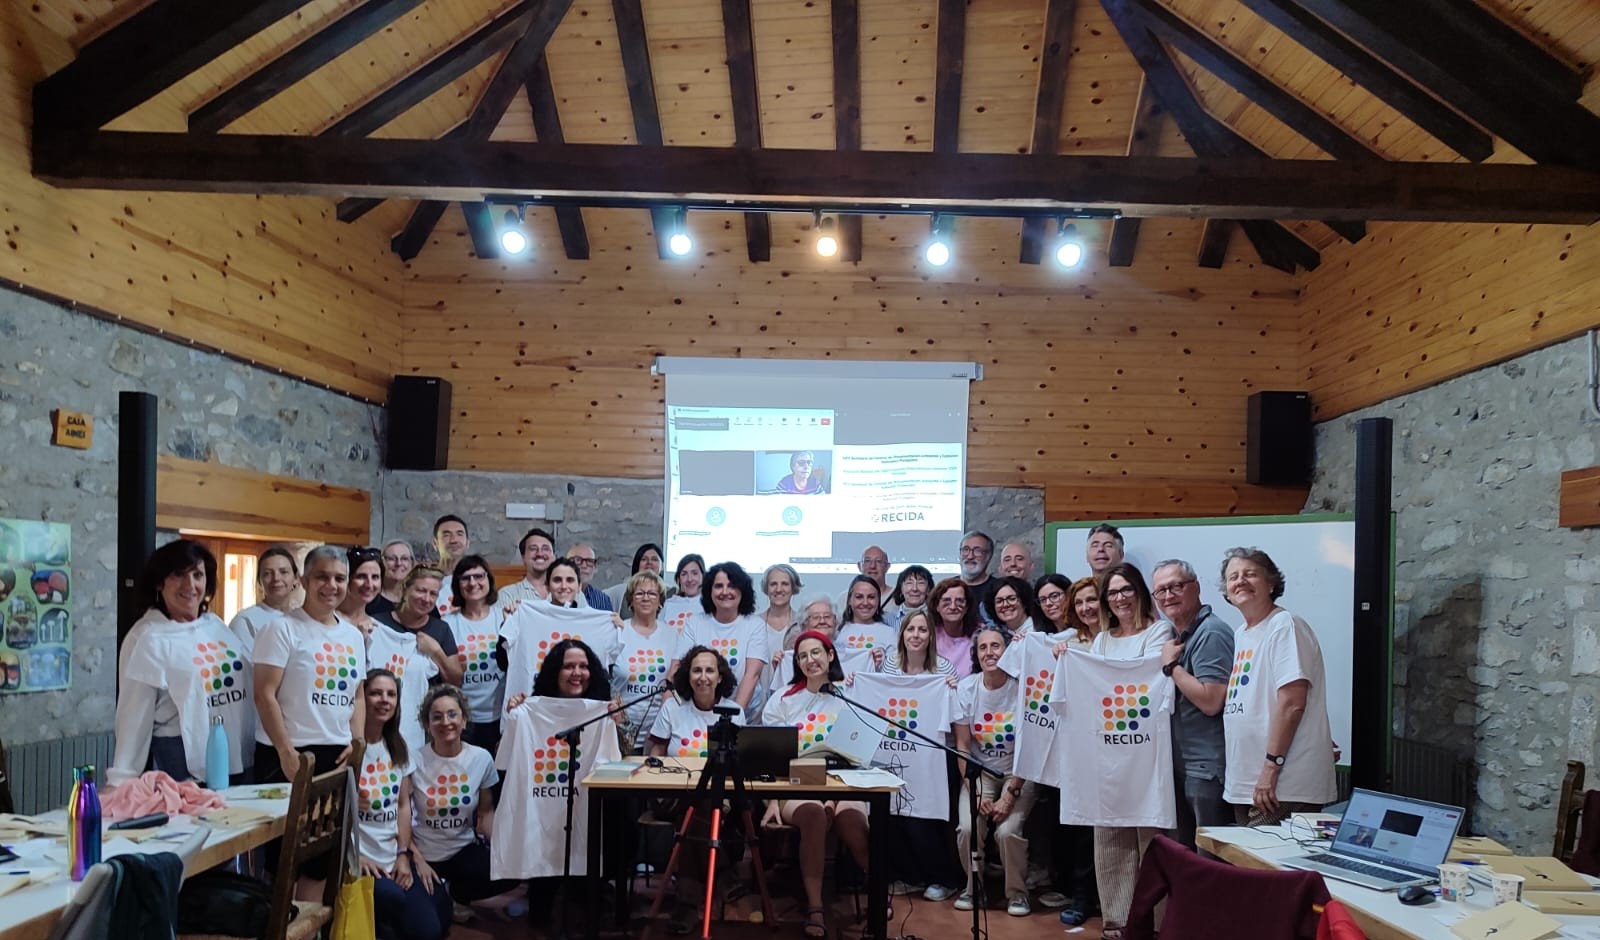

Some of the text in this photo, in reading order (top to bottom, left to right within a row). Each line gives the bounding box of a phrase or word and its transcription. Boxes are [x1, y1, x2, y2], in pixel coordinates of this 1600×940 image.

[881, 512, 925, 522] RECIDA
[465, 672, 501, 684] ECIDA
[311, 692, 355, 707] RECIDA
[1023, 711, 1055, 731] ECIDA
[1104, 732, 1151, 745] RECIDA
[532, 786, 579, 798] RECIDA
